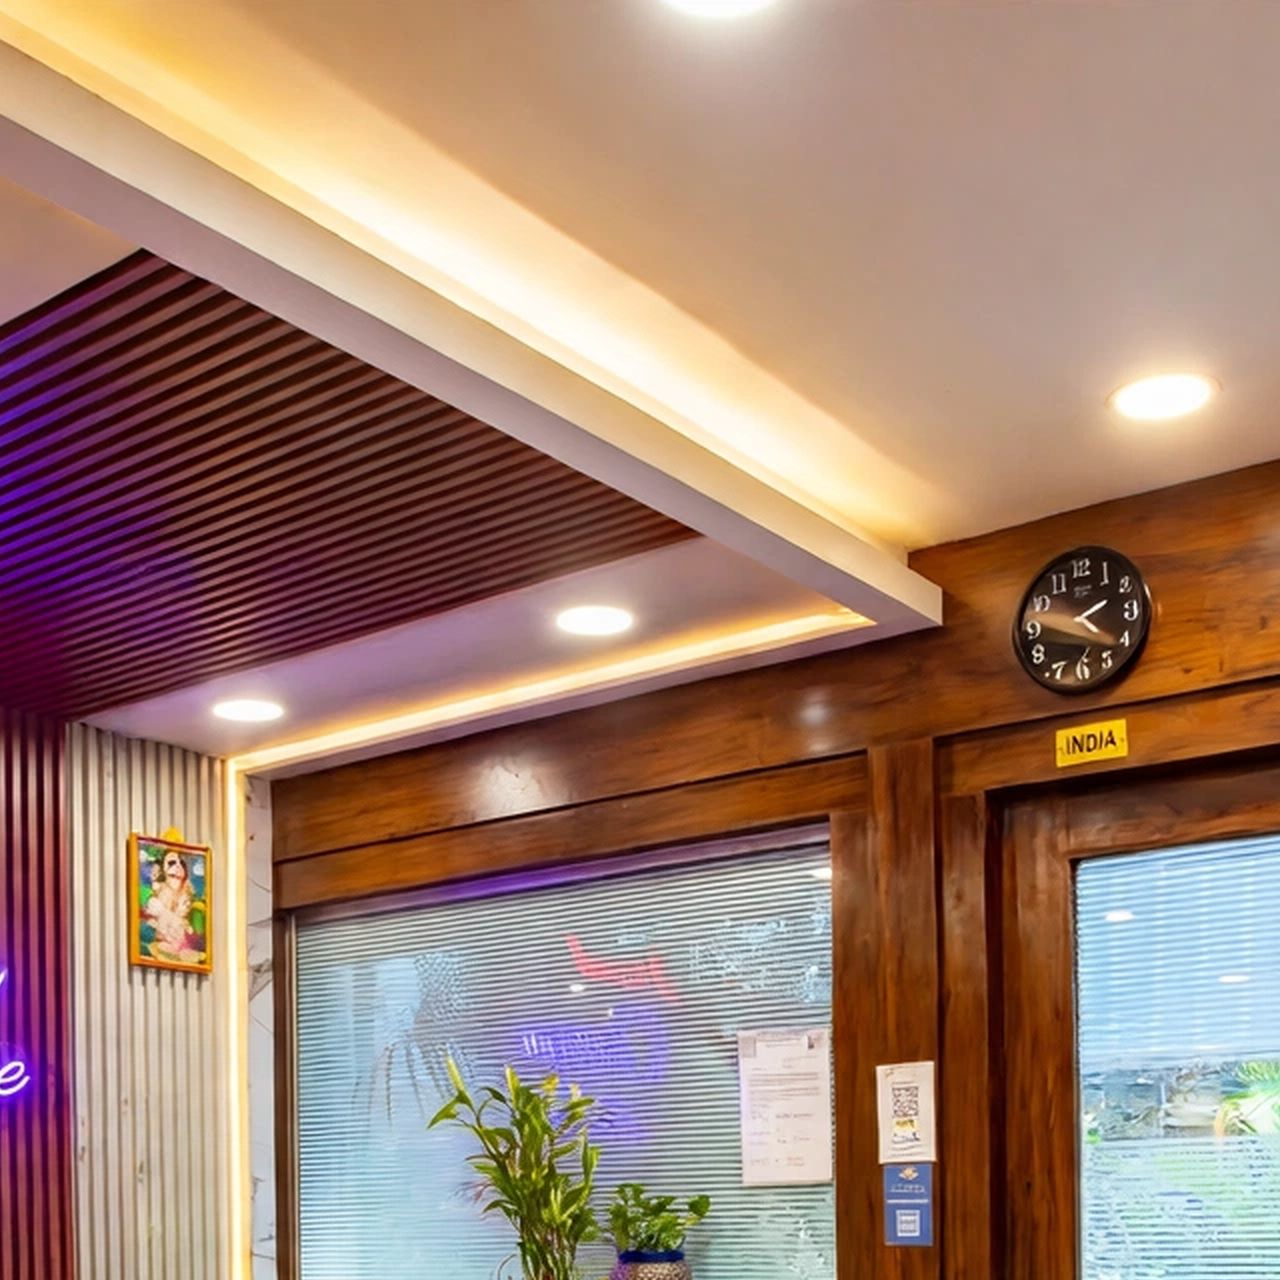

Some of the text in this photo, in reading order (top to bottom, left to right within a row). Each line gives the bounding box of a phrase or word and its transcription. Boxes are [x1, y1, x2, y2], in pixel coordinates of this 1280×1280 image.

[1072, 558, 1090, 578] 12
[1100, 562, 1109, 586] 1
[1119, 576, 1132, 593] 2
[1033, 595, 1050, 612] 10
[1124, 600, 1139, 620] 3
[1027, 621, 1041, 639] 9
[1120, 630, 1129, 647] 4
[1032, 644, 1045, 664] 8
[1102, 651, 1113, 669] 5
[1052, 661, 1067, 679] 7
[1076, 650, 1090, 679] 6
[1065, 729, 1117, 755] INDIA
